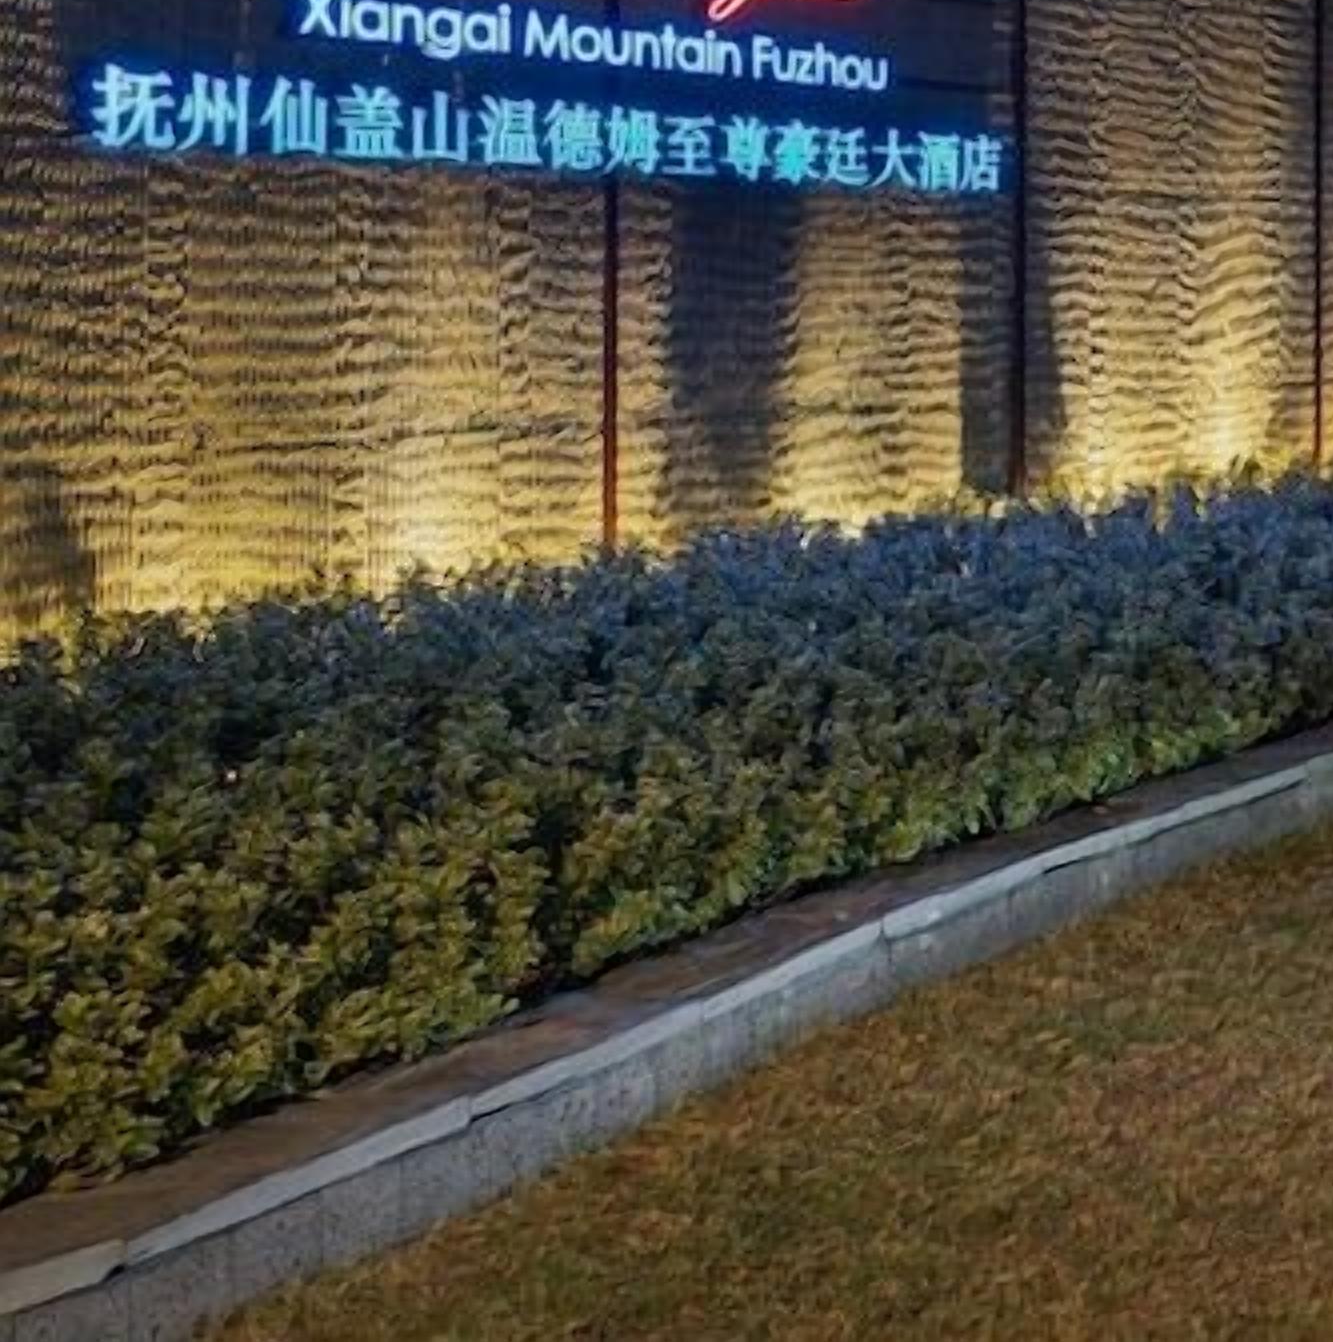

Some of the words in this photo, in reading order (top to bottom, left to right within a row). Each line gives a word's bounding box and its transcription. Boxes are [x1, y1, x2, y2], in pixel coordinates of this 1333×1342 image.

[524, 9, 742, 77] Mountain
[753, 33, 887, 91] Fuzhou
[91, 63, 1002, 193] 抚州仙盖山温德姆至尊豪廷大酒店
